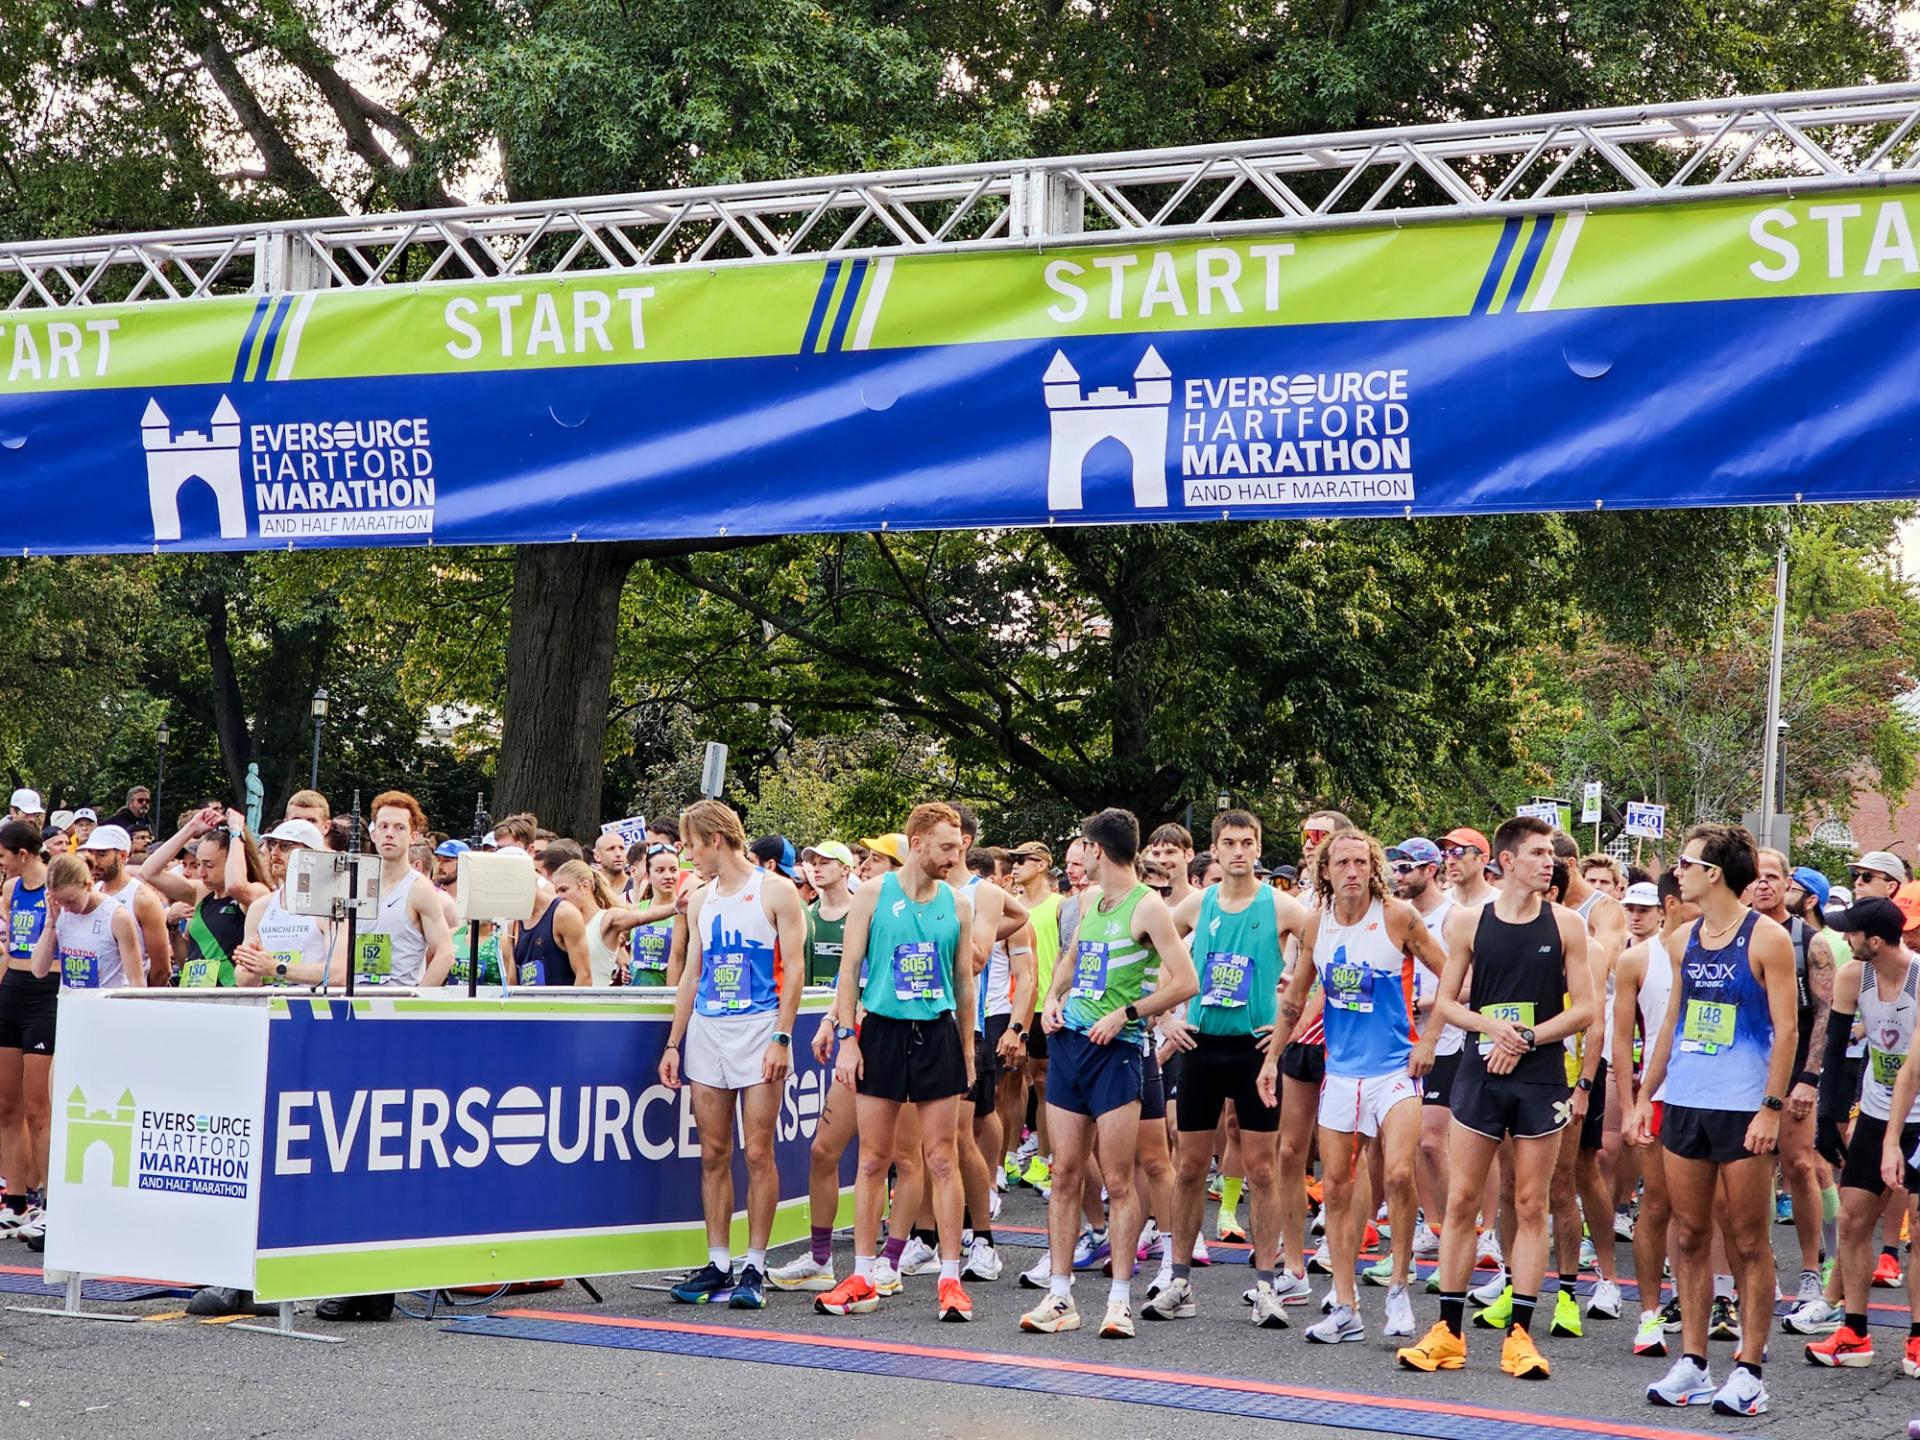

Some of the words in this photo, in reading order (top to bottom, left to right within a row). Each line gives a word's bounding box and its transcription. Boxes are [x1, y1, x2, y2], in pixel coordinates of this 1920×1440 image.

[1044, 243, 1296, 323] START
[444, 286, 655, 360] START
[0, 319, 120, 382] ART
[1185, 369, 1408, 410] EVERSOURCE
[1183, 403, 1409, 442] HARTFORD
[250, 418, 430, 452] EVERSOURCE
[252, 448, 433, 482] HARTFORD
[1182, 437, 1411, 476] MARATHON
[255, 478, 435, 511] MARATHON
[1190, 485, 1232, 502] AND
[1238, 482, 1287, 501] HALF
[1293, 479, 1408, 499] MARATHON
[264, 519, 297, 534] AND
[301, 517, 338, 532] HALF
[342, 514, 428, 532] MARATHON
[1632, 812, 1659, 828] 1:40
[261, 924, 310, 934] MANCHESTER
[62, 946, 97, 958] BOSTON
[362, 945, 381, 959] 152
[639, 937, 665, 949] 3009
[65, 957, 91, 972] 3004
[726, 953, 744, 963] 3057
[900, 957, 934, 973] 3051
[189, 963, 207, 976] 130
[713, 967, 743, 984] 3057
[1210, 965, 1245, 985] 3048
[1332, 967, 1365, 986] 3047
[1687, 963, 1737, 980] RADIX
[1493, 1007, 1520, 1022] 125
[1698, 1006, 1722, 1024] 148
[142, 1111, 252, 1138] EVERSOURCE
[274, 1085, 702, 1176] EVERSOURCE
[140, 1130, 251, 1158] HARTFORD
[139, 1151, 249, 1180] MARATHON
[140, 1176, 164, 1190] AND
[165, 1178, 191, 1193] HALF
[192, 1181, 246, 1198] MARATHON
